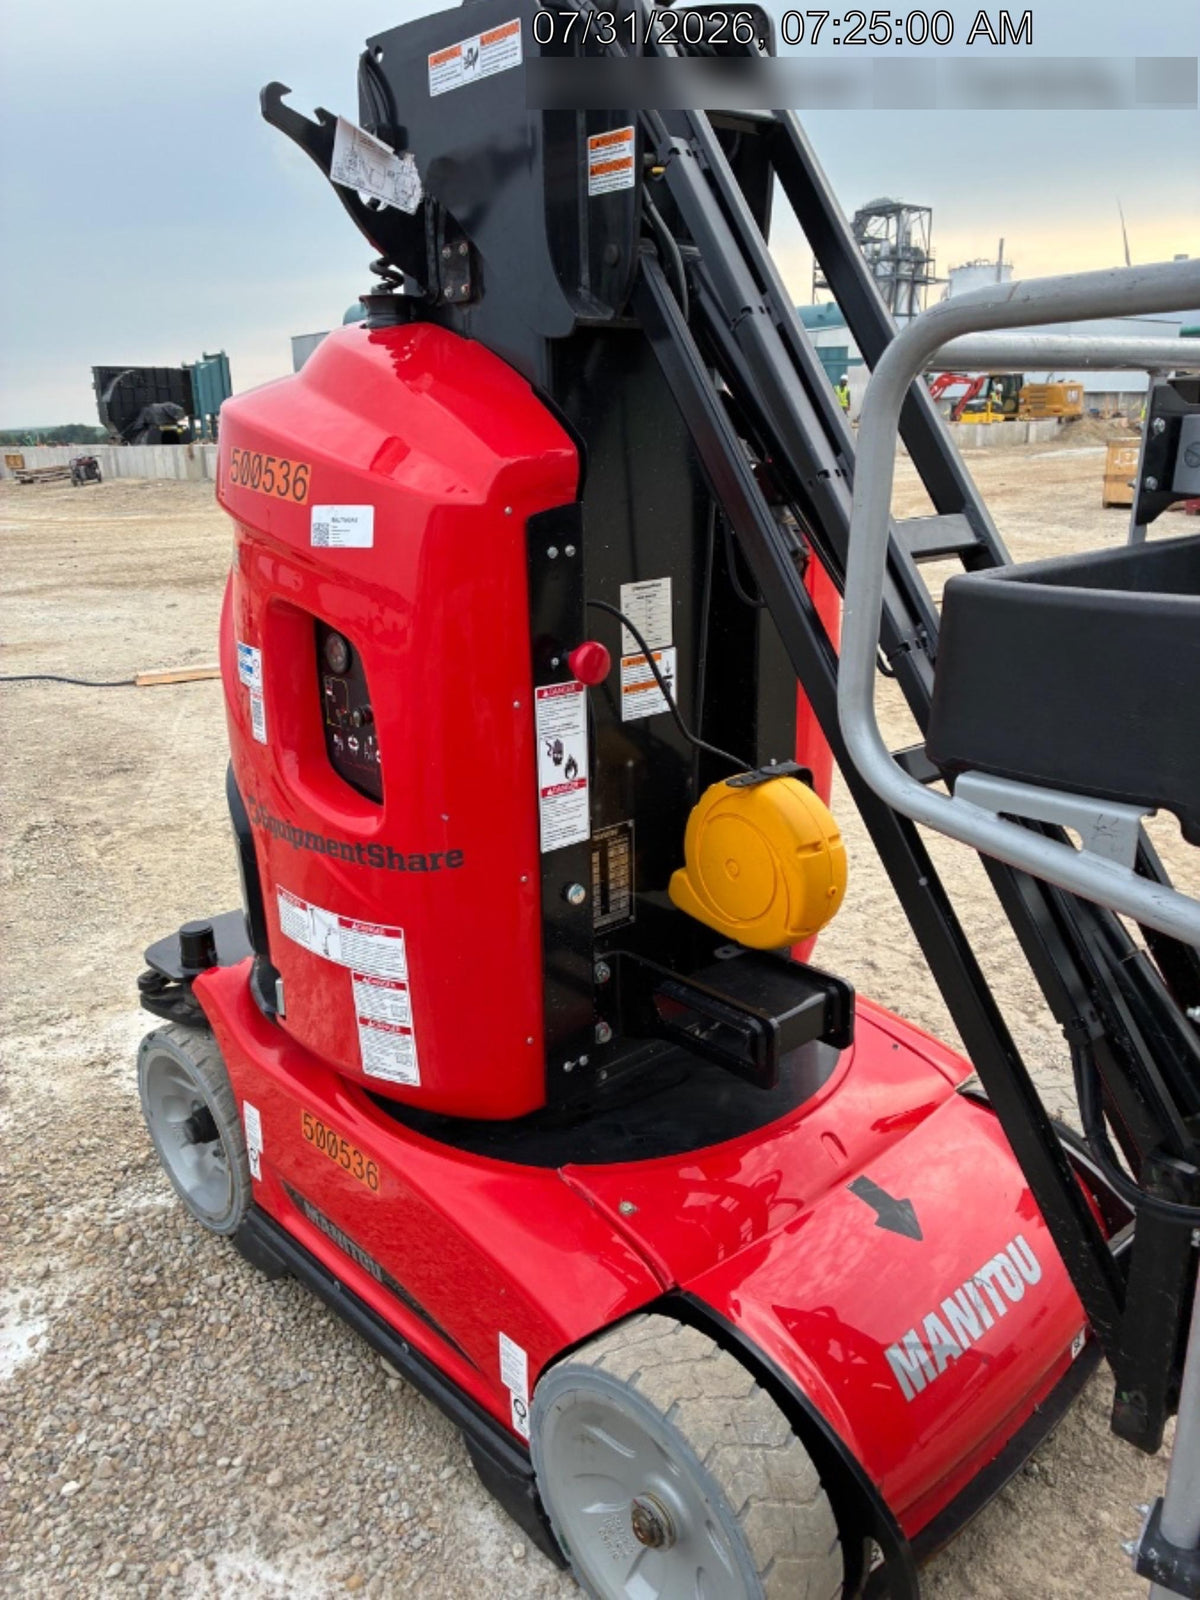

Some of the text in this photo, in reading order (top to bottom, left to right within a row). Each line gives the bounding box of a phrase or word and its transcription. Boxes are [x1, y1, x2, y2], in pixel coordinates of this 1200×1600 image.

[230, 448, 309, 502] 500536
[261, 806, 464, 872] EquipmentShare
[302, 1112, 380, 1192] 500536
[303, 1199, 383, 1282] MANITOU
[884, 1234, 1042, 1403] MANITOU
